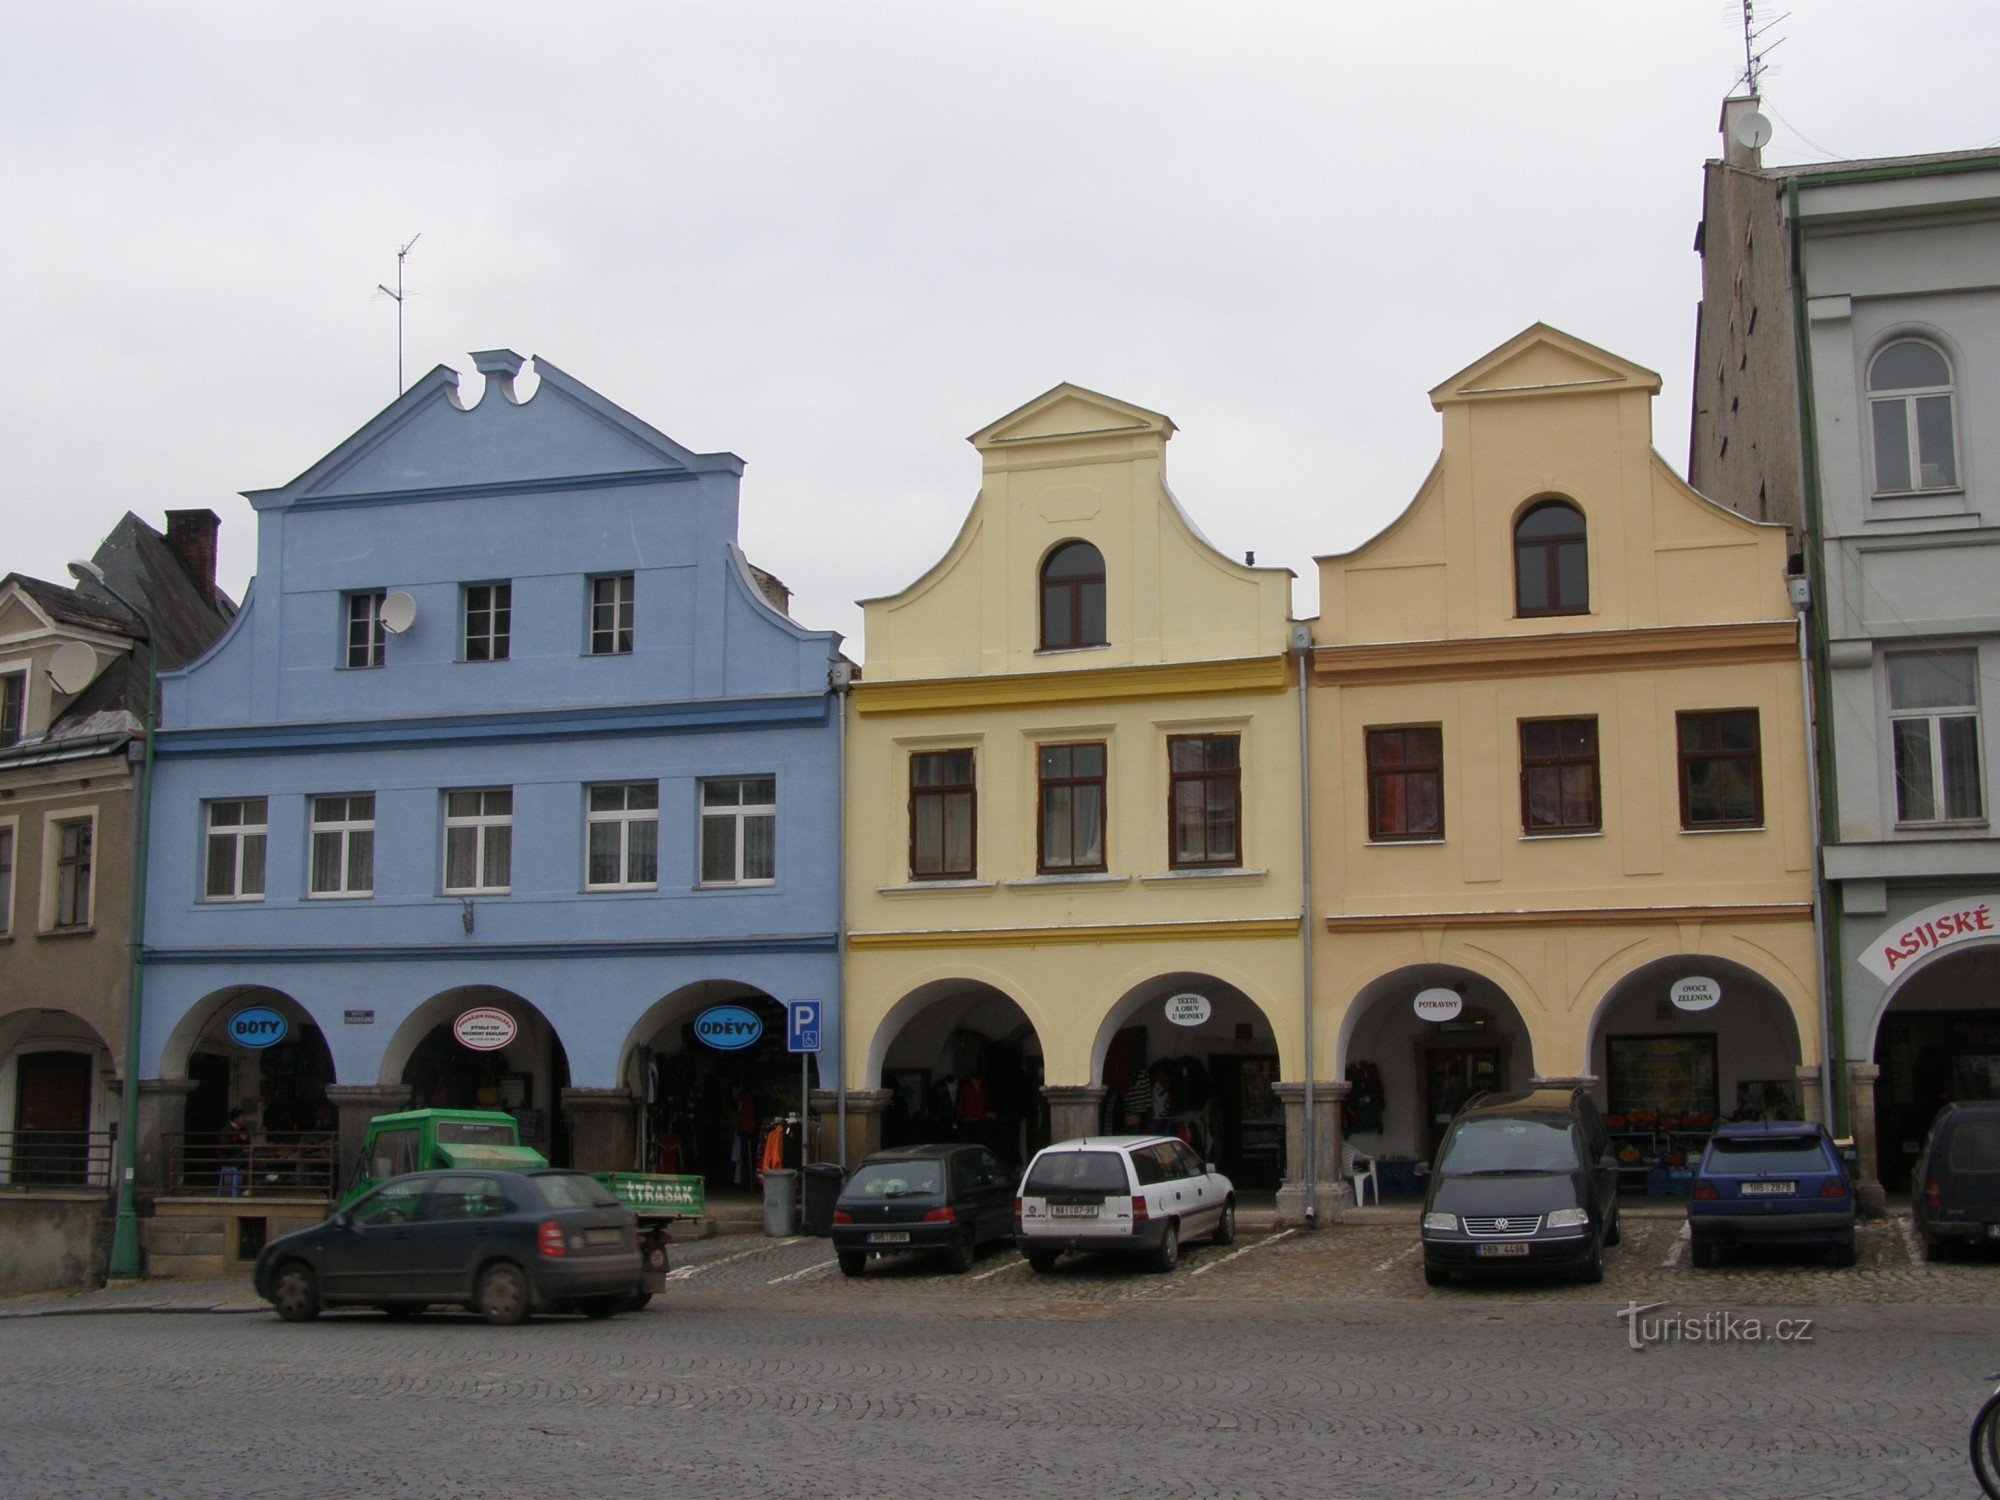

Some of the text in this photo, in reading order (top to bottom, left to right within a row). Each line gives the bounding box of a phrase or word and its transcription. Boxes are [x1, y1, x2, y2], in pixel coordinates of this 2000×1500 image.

[1883, 904, 1994, 970] ASIJSKÉ
[1678, 994, 1713, 1002] ZELENINA
[795, 1006, 815, 1036] P
[1178, 1012, 1204, 1020] MONIKY
[236, 1020, 280, 1034] BOTY
[700, 1017, 757, 1035] ODĚVY
